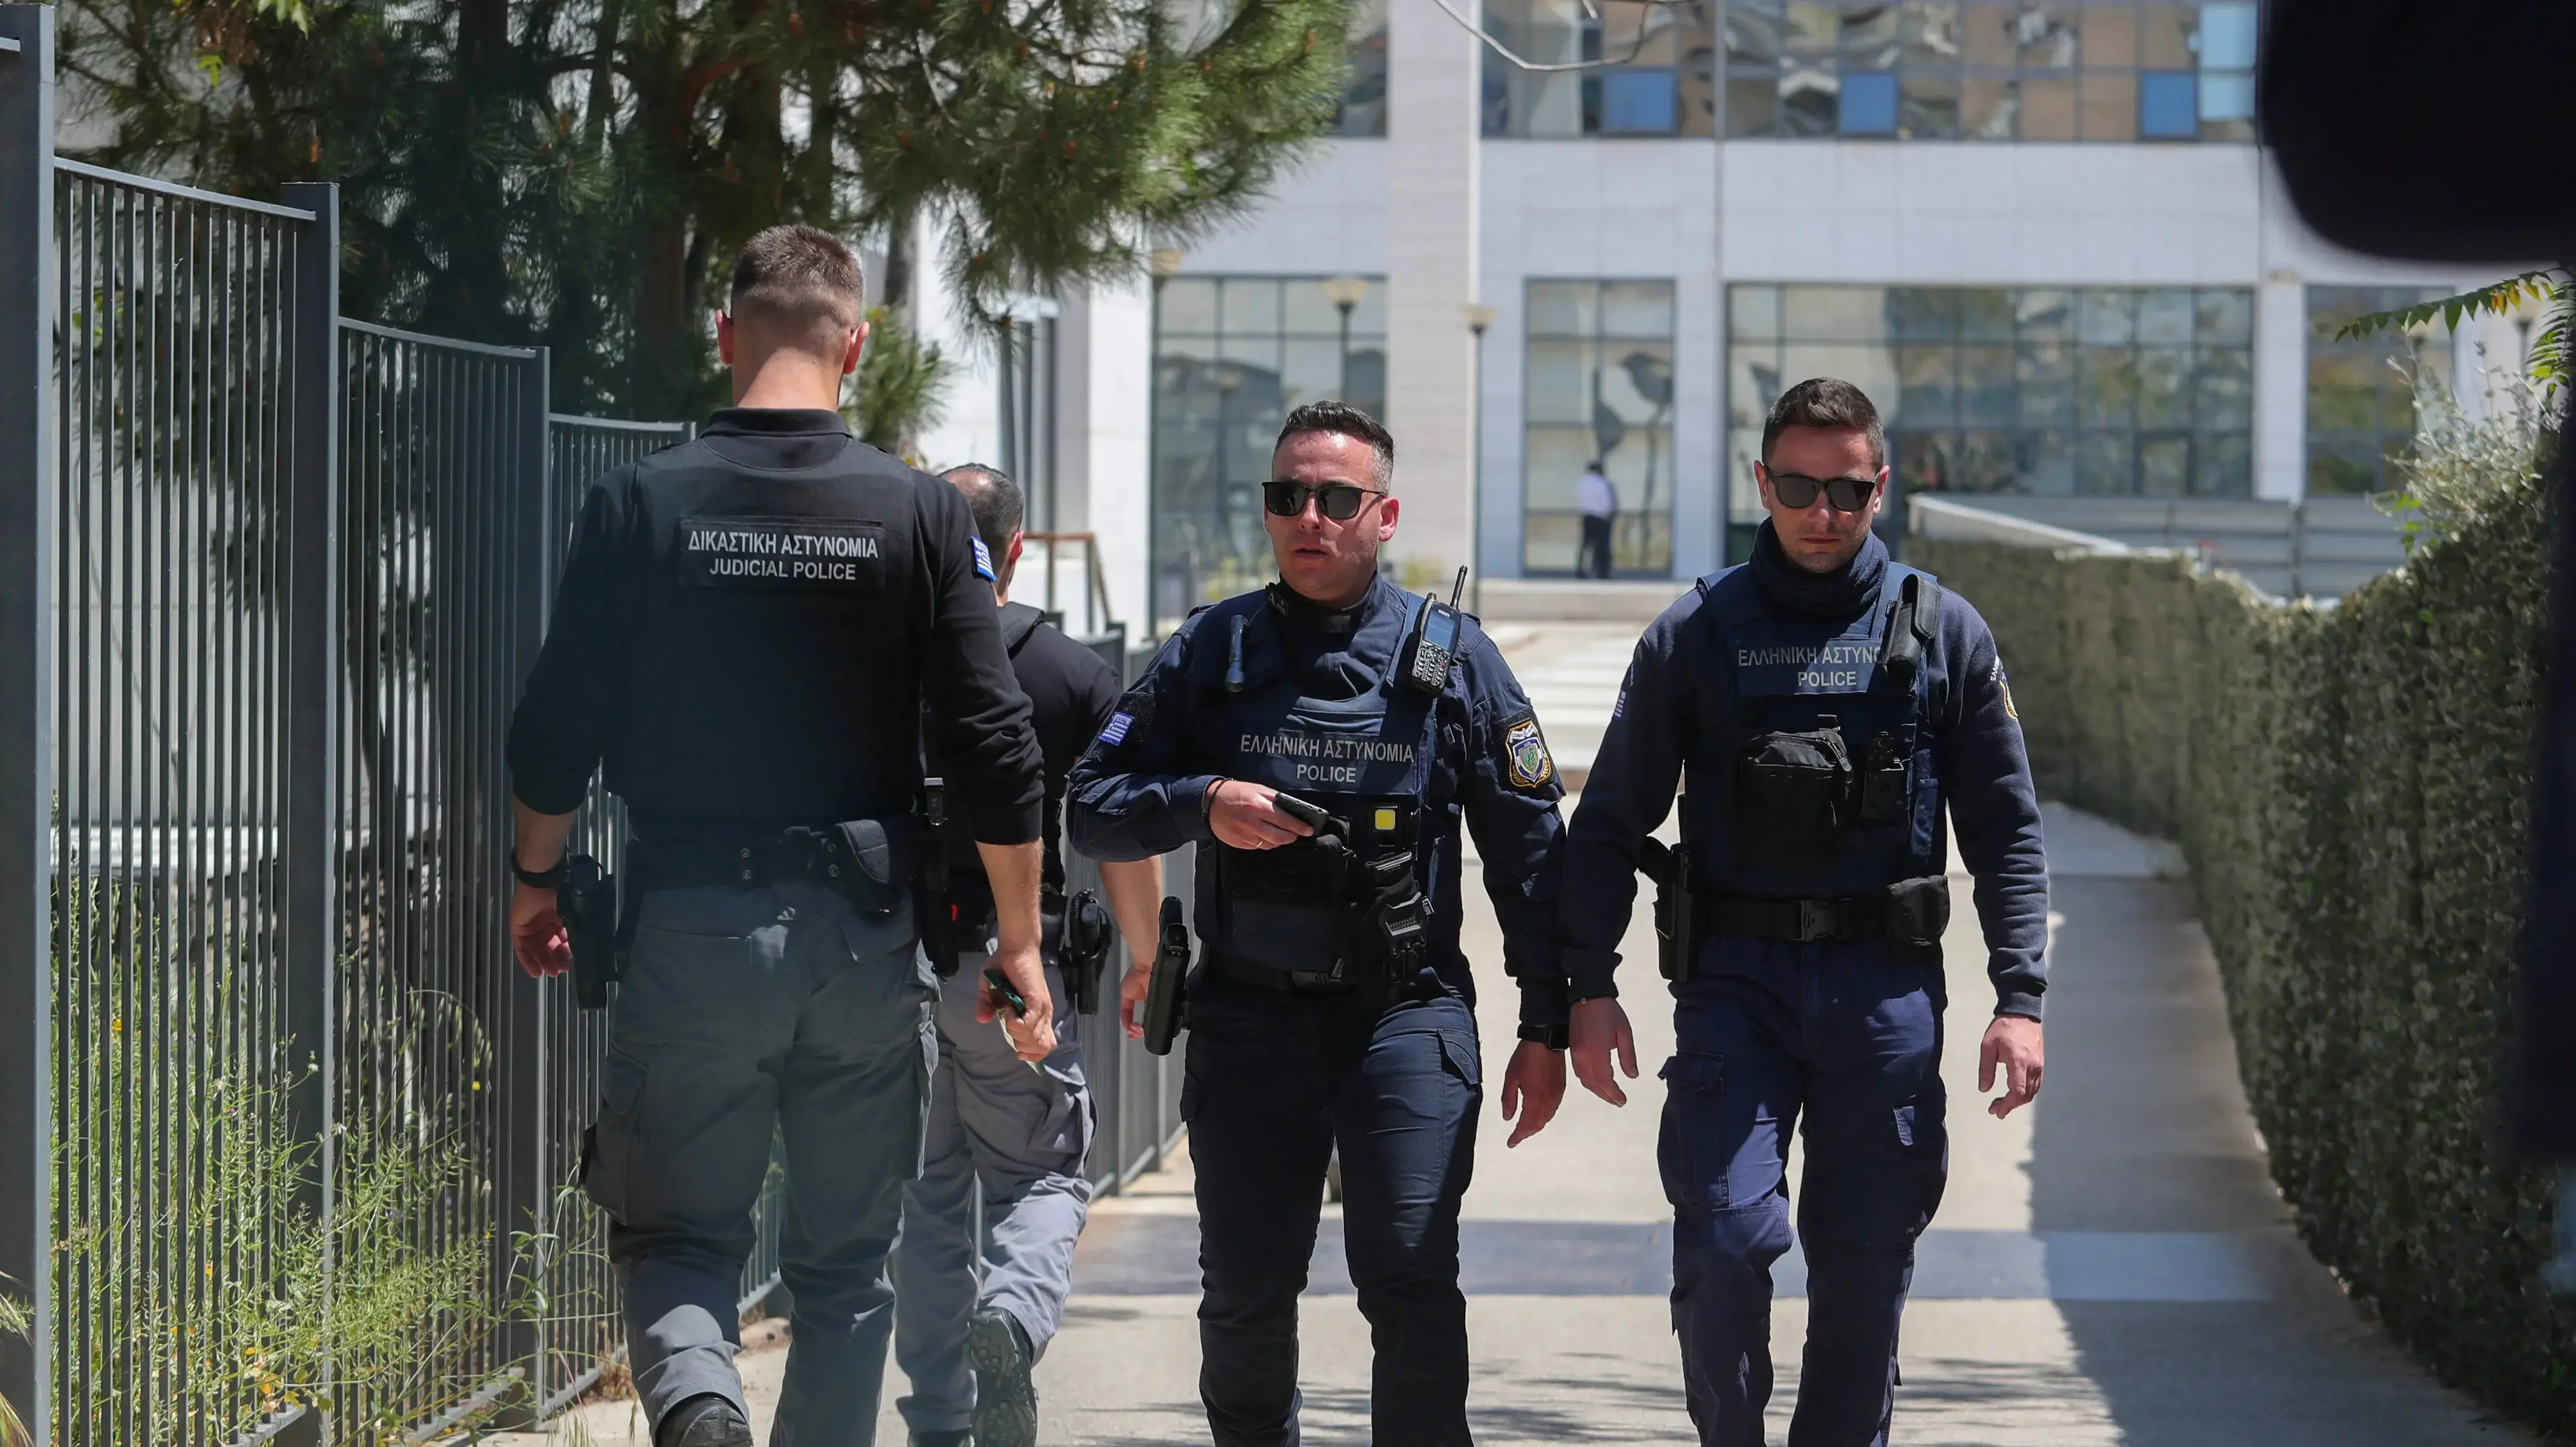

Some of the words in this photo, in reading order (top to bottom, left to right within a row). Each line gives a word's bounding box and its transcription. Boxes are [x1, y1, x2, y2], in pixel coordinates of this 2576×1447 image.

[688, 531, 777, 554] ΔΙΚΑΣΤΙΚΗ
[781, 534, 878, 558] ΑΣΤΥΝΟΜΙΑ
[709, 558, 788, 578] JUDICIAL
[793, 562, 857, 580] POLICE
[1739, 647, 1817, 667] ΕΛΛΗΝΙΚΗ
[1822, 646, 1884, 664] ΑΣΤΥΝΟ
[1798, 671, 1857, 687] POLICE
[1240, 734, 1320, 757] ΕΛΛΗΝΙΚΗ
[1323, 740, 1415, 763] ΑΣΤΥΝΟΜΙΑ
[1296, 764, 1356, 783] POLICE
